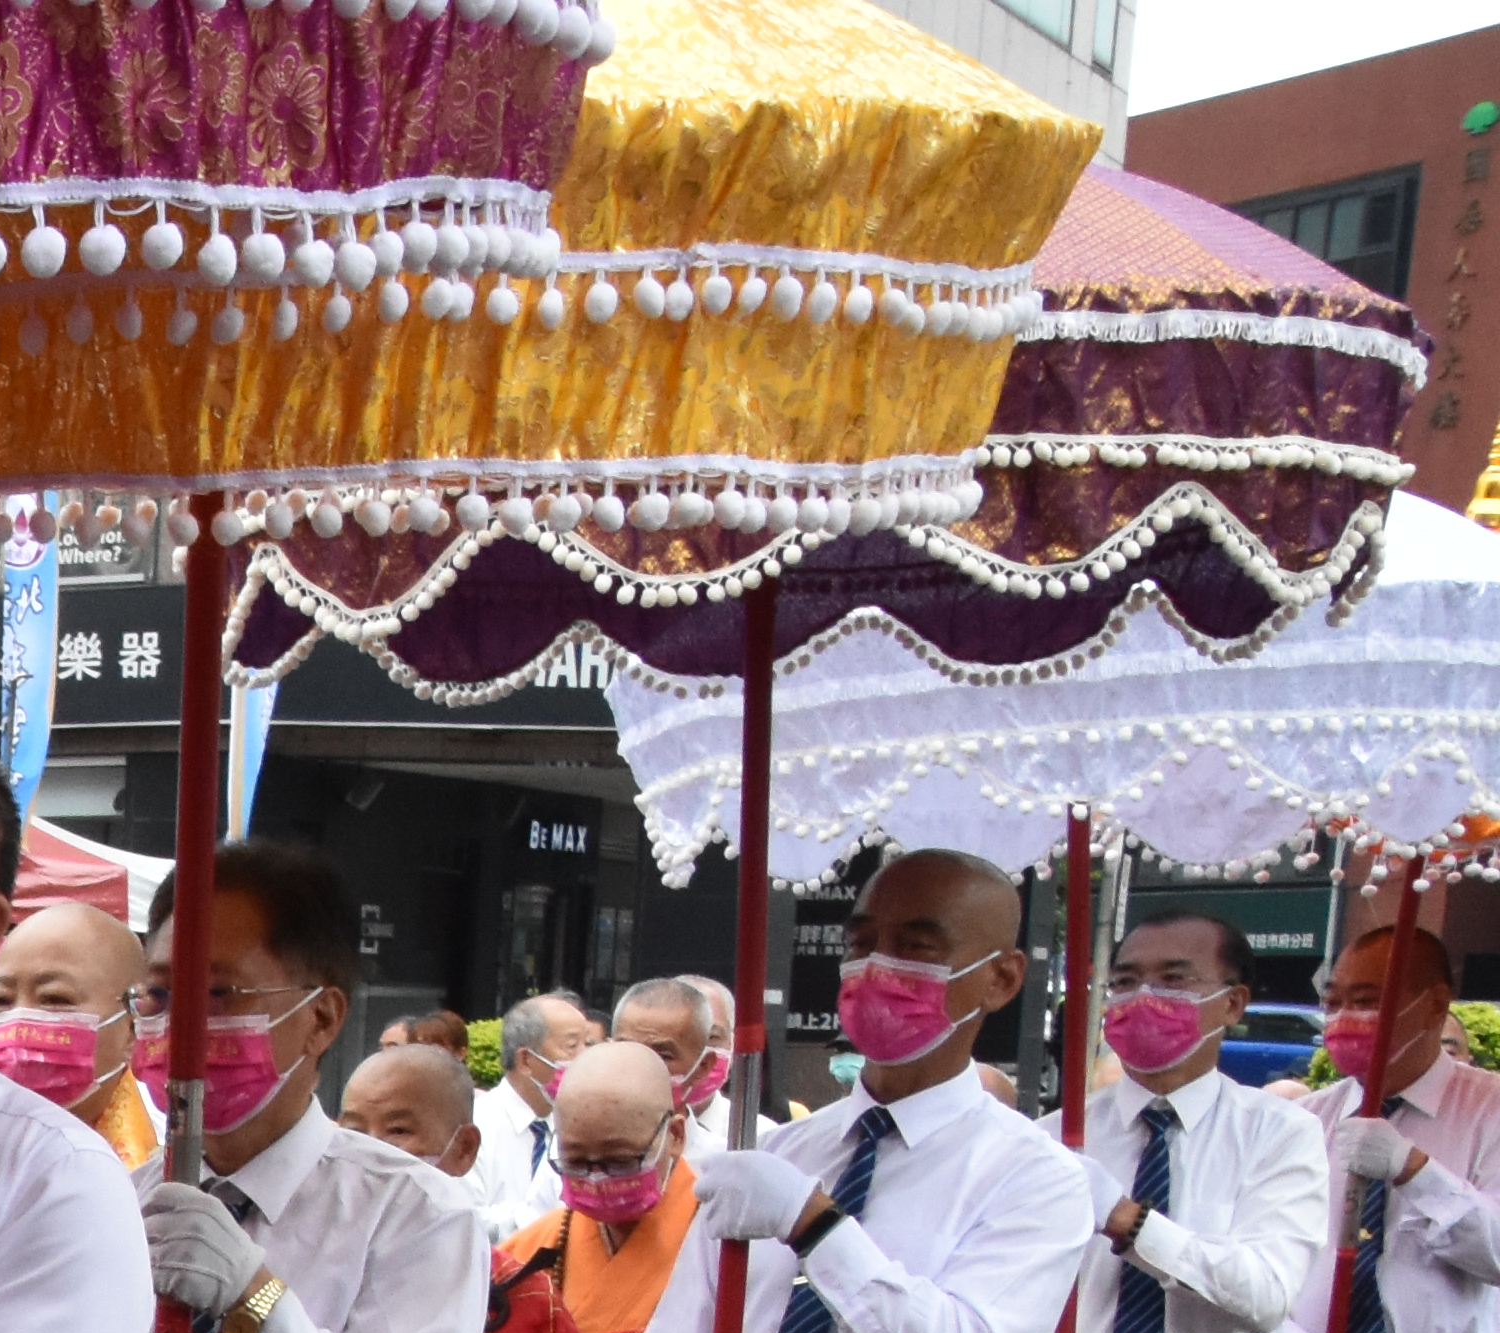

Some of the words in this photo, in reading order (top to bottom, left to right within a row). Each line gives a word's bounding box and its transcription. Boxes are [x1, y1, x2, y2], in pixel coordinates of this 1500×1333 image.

[58, 546, 122, 565] Where?
[58, 632, 162, 681] 樂器
[551, 823, 588, 853] MAX
